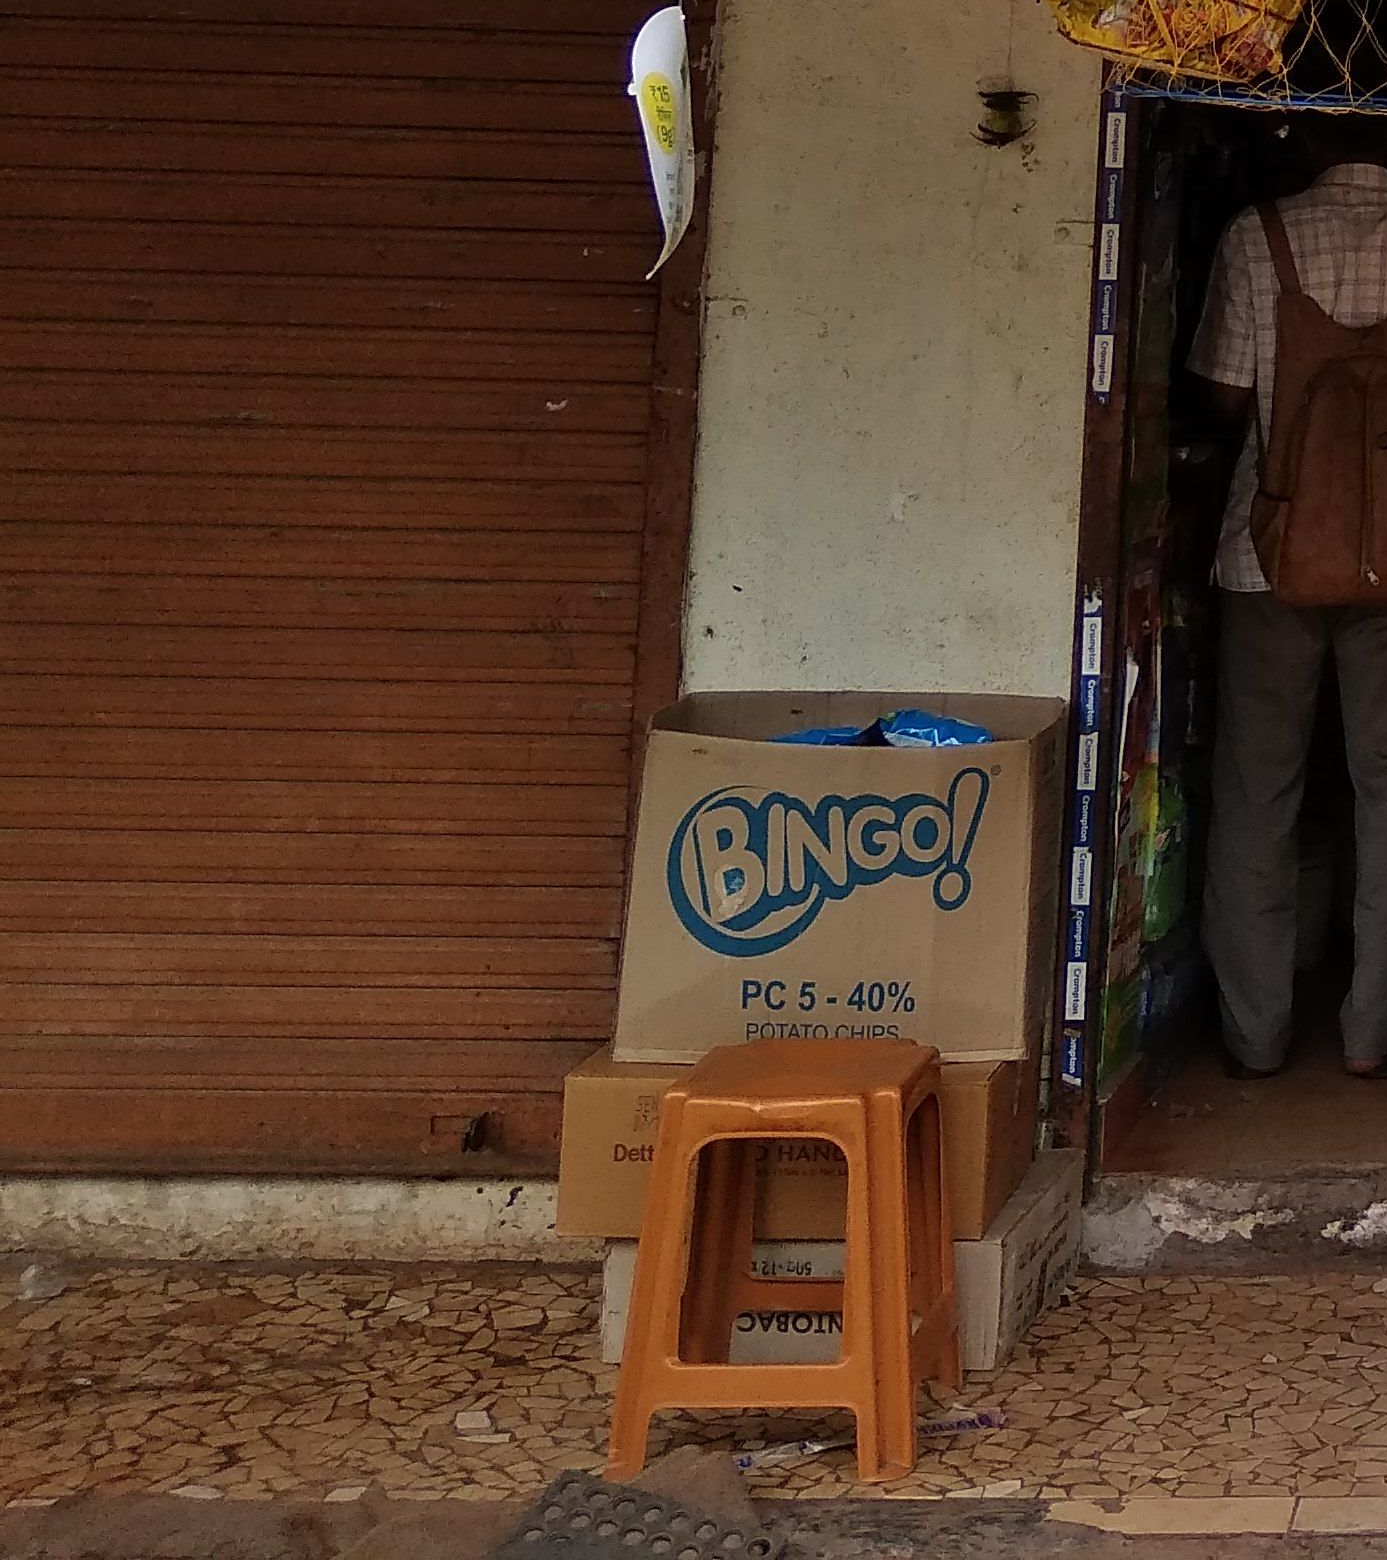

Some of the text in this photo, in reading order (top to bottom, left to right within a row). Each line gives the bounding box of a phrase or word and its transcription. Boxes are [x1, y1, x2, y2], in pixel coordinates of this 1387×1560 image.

[1100, 283, 1113, 331] Crompton
[1098, 339, 1110, 387] Crompton
[1086, 622, 1098, 670] Crompton
[1084, 679, 1097, 727] Crompton
[1081, 737, 1094, 785] Crompton
[1078, 795, 1091, 842] Crompton
[680, 766, 991, 935] BINGO!
[1075, 852, 1088, 900] Crompton
[740, 981, 787, 1012] PC
[798, 982, 816, 1011] 5
[847, 981, 917, 1013] 40%
[1070, 967, 1083, 1015] Crompton
[744, 1022, 901, 1042] POTATO CHIPS
[613, 1143, 655, 1163] Dett
